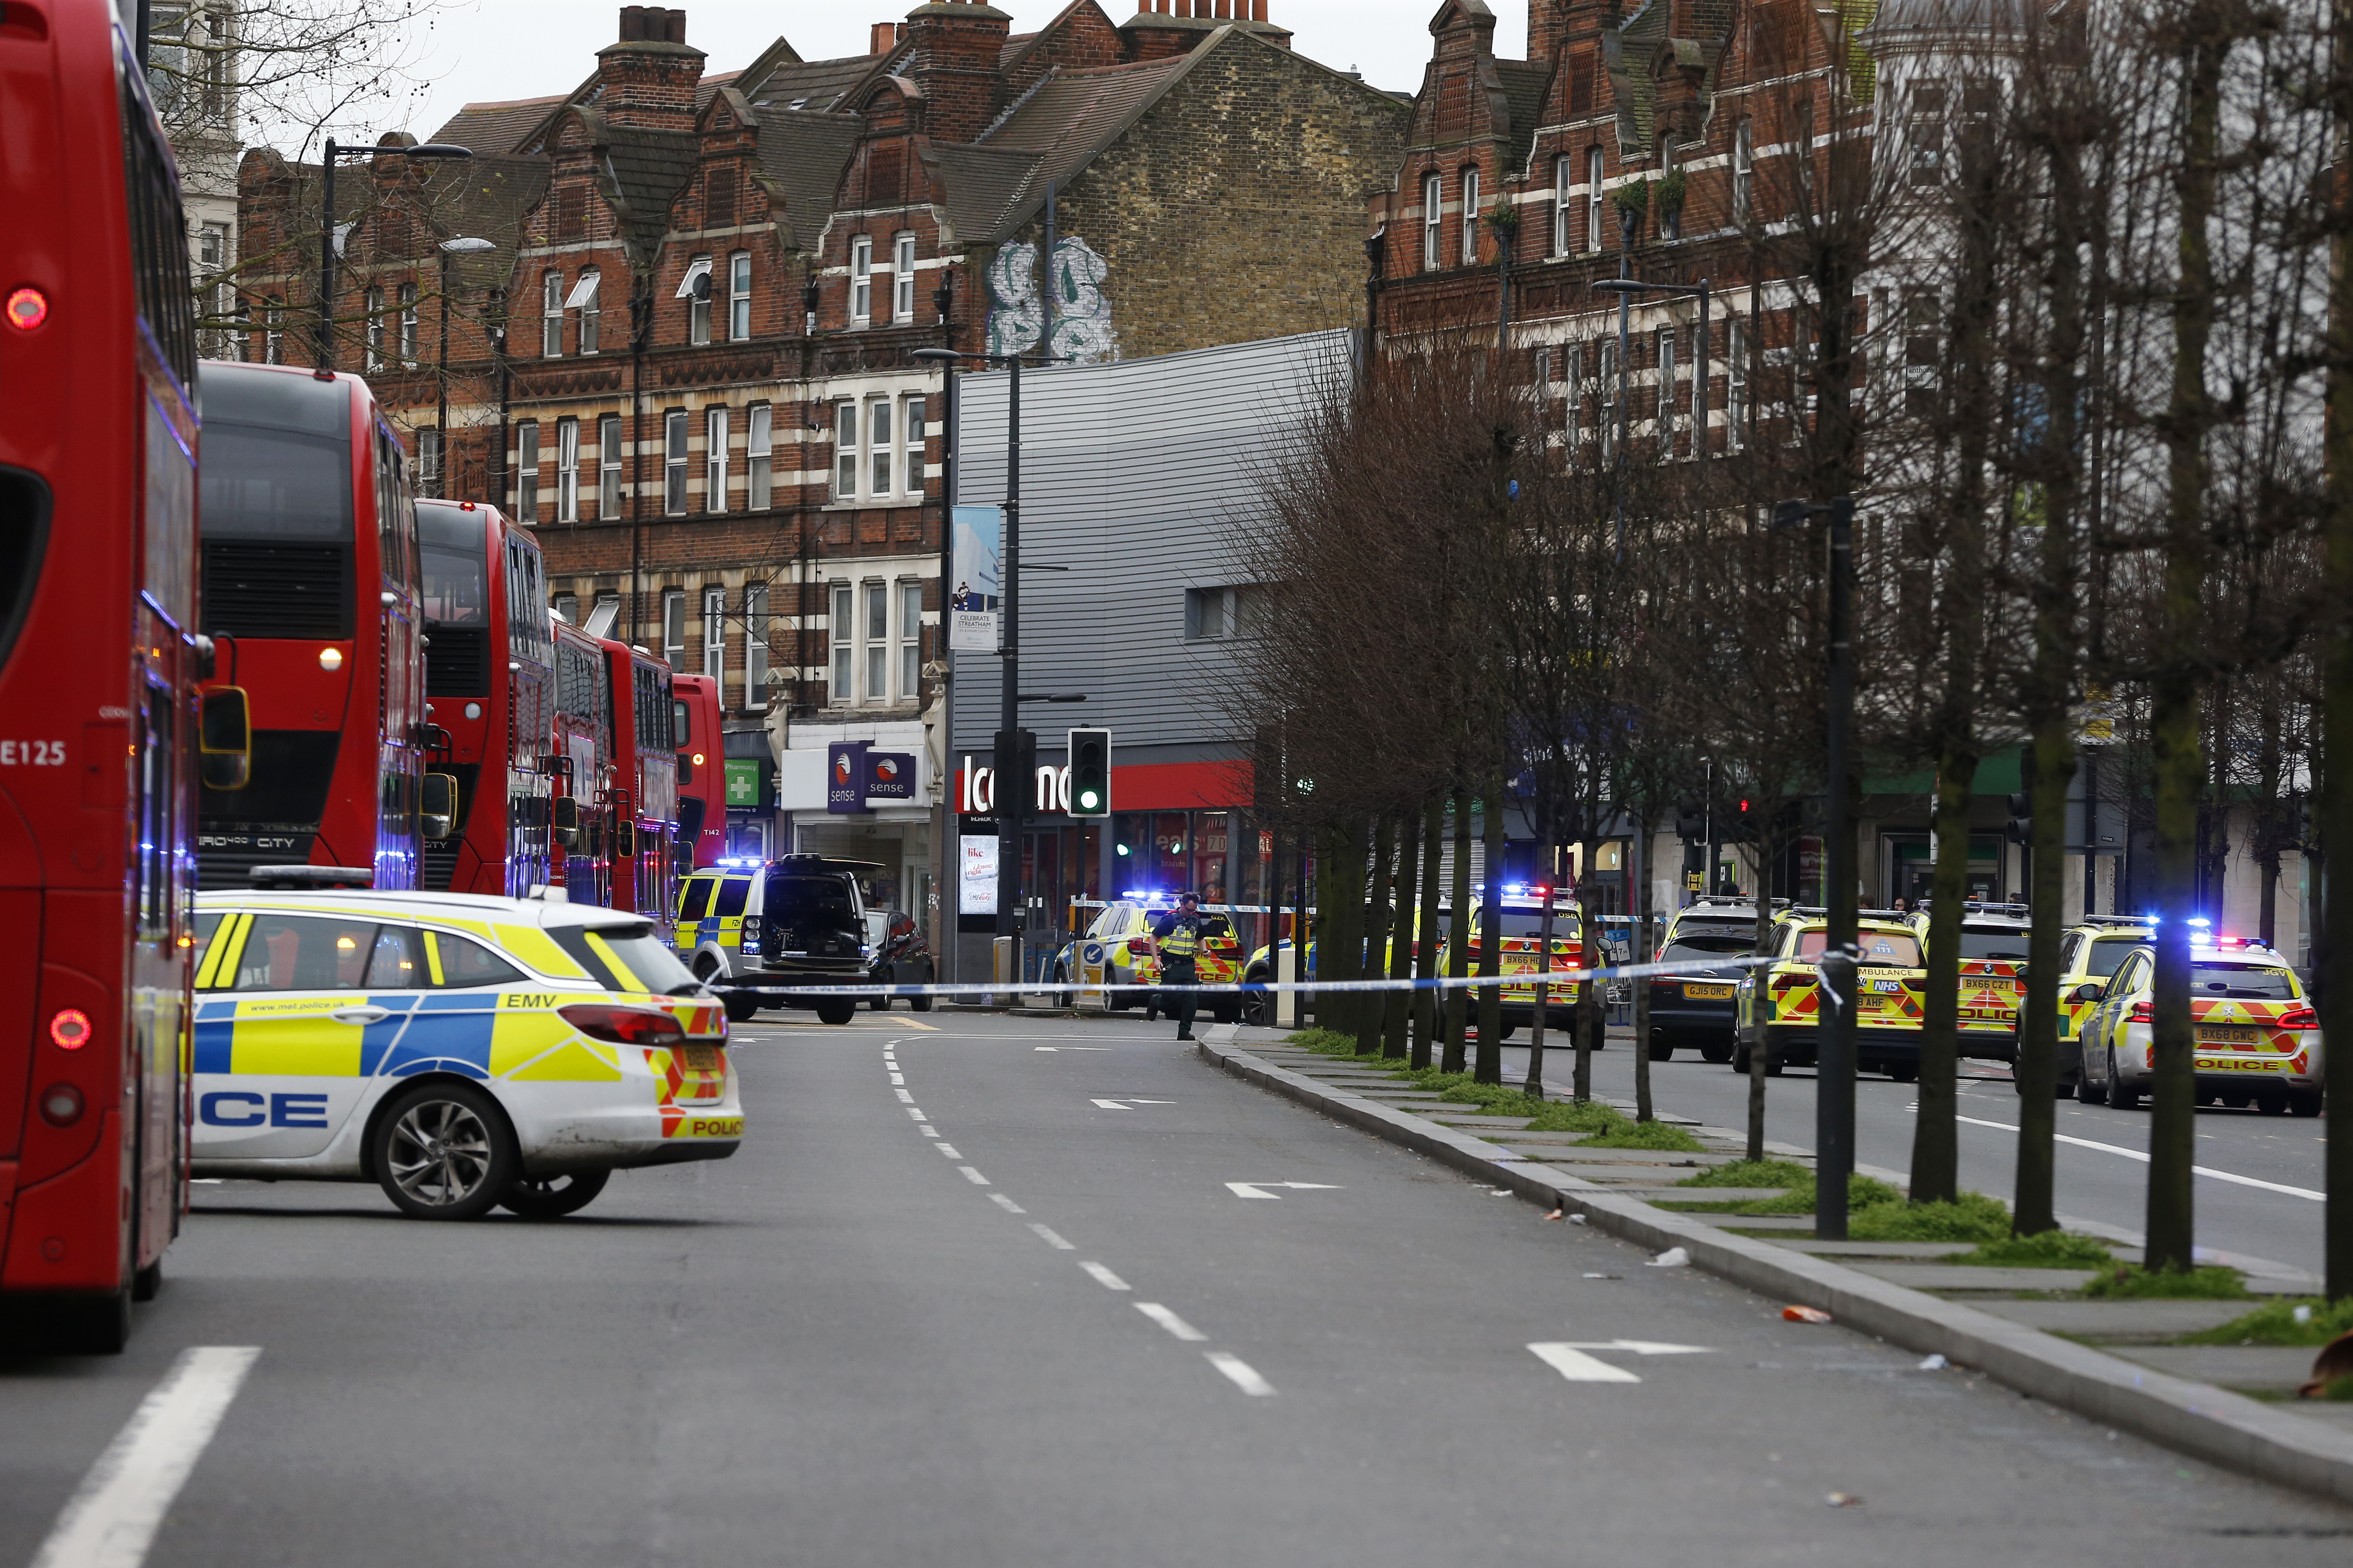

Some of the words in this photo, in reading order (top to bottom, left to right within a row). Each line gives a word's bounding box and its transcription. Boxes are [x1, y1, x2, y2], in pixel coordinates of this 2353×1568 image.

[870, 784, 904, 792] sense
[831, 790, 854, 802] sense
[968, 848, 983, 857] like
[967, 868, 982, 876] right
[968, 892, 980, 901] Diet
[979, 892, 992, 901] Coke
[1507, 956, 1528, 964] BX66
[1874, 981, 1899, 991] NHS
[1966, 979, 1990, 988] BX66
[1992, 981, 2010, 989] CZT
[1690, 987, 1708, 995] GJ15
[508, 994, 556, 1008] EMV
[1866, 997, 1884, 1006] AHF
[250, 1001, 345, 1012] www.met.police.uk
[2201, 1029, 2229, 1039] BX68
[2233, 1030, 2254, 1041] GWC
[2194, 1059, 2279, 1070] OLICE
